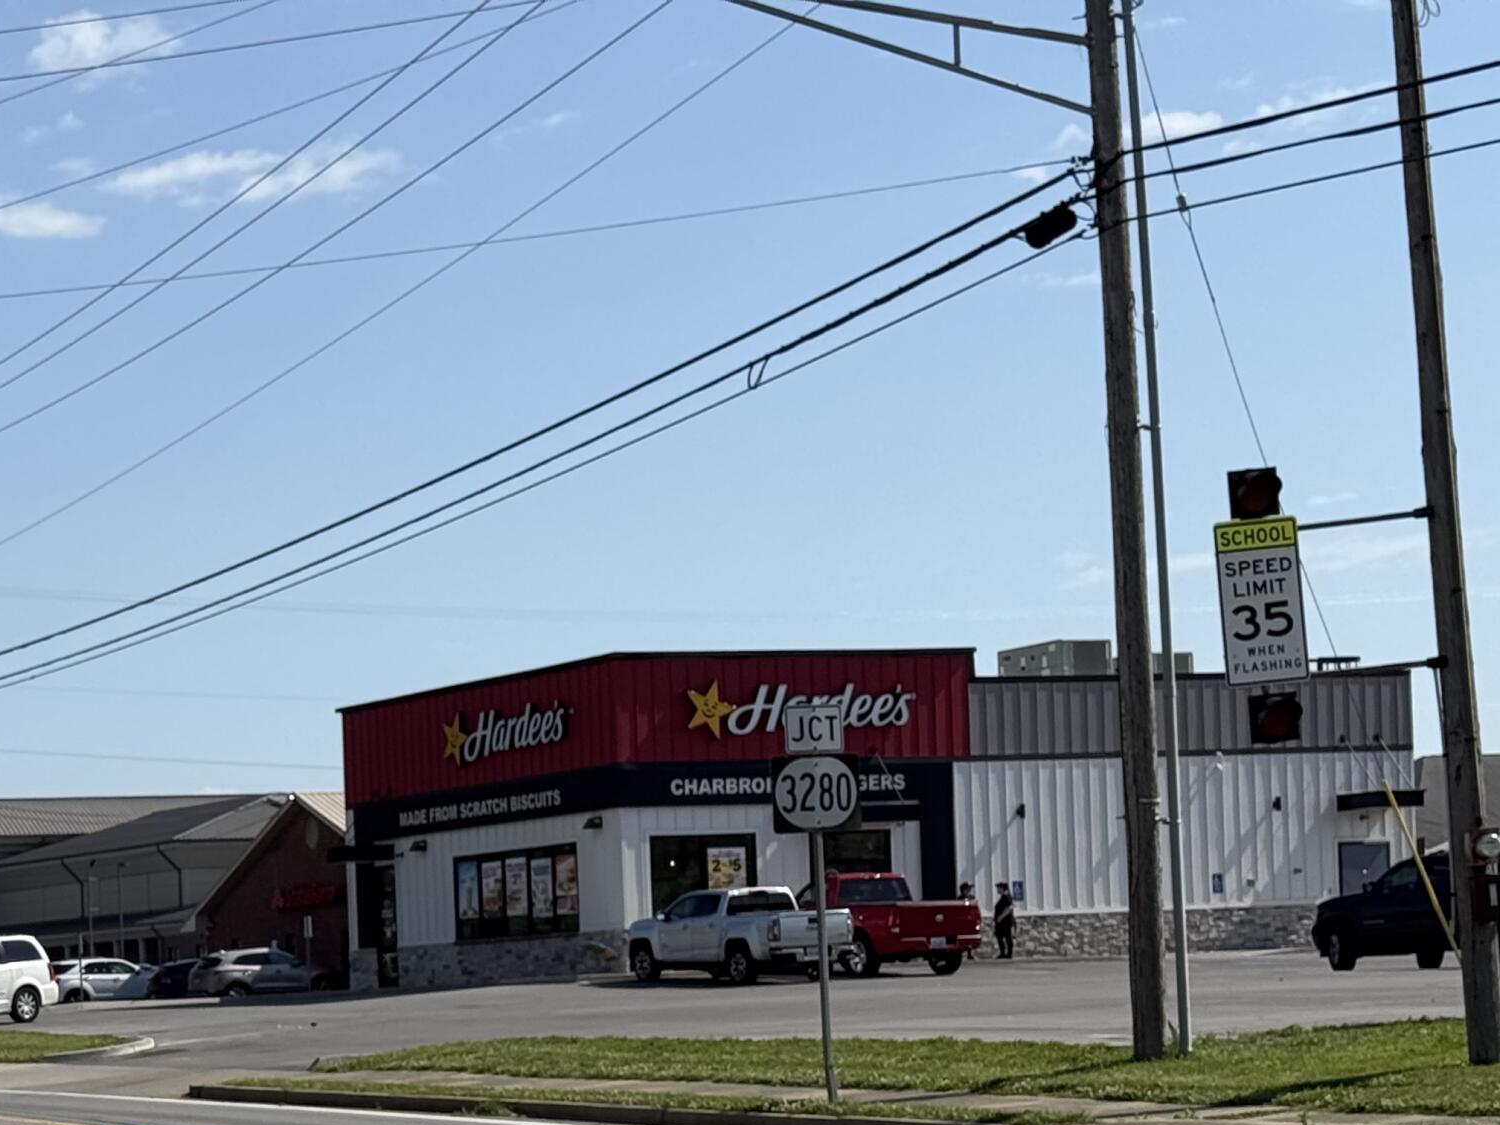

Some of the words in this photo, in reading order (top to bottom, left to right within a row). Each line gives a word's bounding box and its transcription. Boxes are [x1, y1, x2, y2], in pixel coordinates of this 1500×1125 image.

[1220, 525, 1292, 547] SCHOOL
[1224, 557, 1292, 577] SPEED
[1232, 578, 1286, 598] LIMIT
[1232, 600, 1294, 641] 35
[1247, 644, 1285, 657] WHEN
[1234, 657, 1302, 675] FLASHING
[463, 699, 565, 762] Hardee's
[791, 715, 838, 742] JCT
[670, 777, 772, 796] CHARBROI
[858, 774, 906, 792] GERS
[780, 772, 850, 814] 3280
[399, 810, 427, 827] MADE
[429, 804, 458, 824] FROM
[460, 797, 508, 819] SCRATCH
[510, 788, 562, 812] BISCUITS
[712, 859, 722, 872] 2
